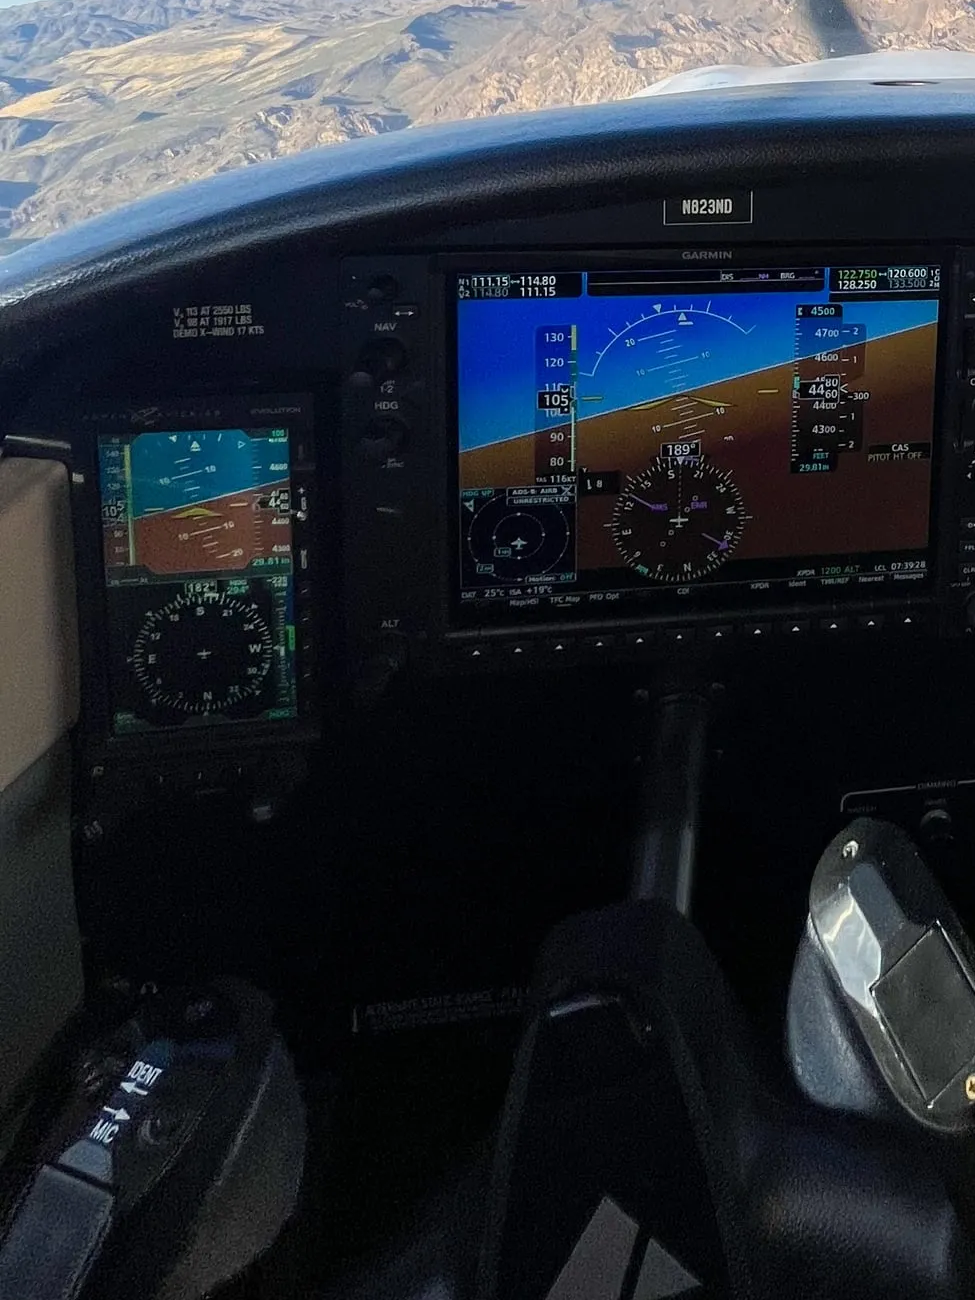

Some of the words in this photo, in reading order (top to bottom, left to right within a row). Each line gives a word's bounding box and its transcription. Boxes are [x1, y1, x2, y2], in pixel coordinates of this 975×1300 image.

[682, 198, 733, 215] N823ND
[682, 251, 733, 260] GARMIN
[838, 269, 877, 279] 122.750
[888, 268, 927, 278] 120.600
[473, 276, 509, 287] 111.15
[520, 276, 556, 286] 114.80
[838, 280, 877, 290] 128.250
[889, 279, 926, 288] 133.500
[473, 288, 509, 297] 114.80
[520, 287, 556, 297] 111.15
[200, 306, 211, 316] AT
[212, 305, 234, 315] 2550
[235, 304, 252, 315] LBS
[811, 307, 835, 316] 4500
[200, 317, 210, 326] AT
[213, 316, 233, 326] 1917
[235, 315, 252, 325] LBS
[237, 326, 247, 336] 17
[248, 325, 265, 335] KTS
[374, 323, 397, 331] NAV
[853, 327, 859, 336] 2
[544, 333, 565, 343] 130
[815, 329, 840, 338] 4700
[625, 338, 636, 347] 20
[701, 351, 711, 359] 10
[815, 353, 839, 362] 4600
[544, 358, 565, 367] 120
[636, 368, 646, 377] 10
[543, 395, 569, 406] 105
[374, 401, 399, 410] HDG
[716, 407, 725, 416] 10
[652, 425, 662, 434] 10
[812, 425, 836, 434] 4300
[550, 433, 565, 442] 90
[849, 441, 855, 449] 2
[892, 443, 909, 451] CAS
[868, 453, 892, 462] PITOT
[894, 453, 905, 461] HT
[907, 452, 922, 460] OFF
[550, 457, 564, 467] 80
[668, 470, 676, 479] S
[693, 470, 704, 479] 21
[683, 562, 692, 572] N
[821, 567, 841, 575] 1200
[844, 565, 860, 573] ALT
[891, 561, 926, 571] 07:39:28
[196, 606, 205, 616] S
[222, 609, 233, 617] 21
[381, 619, 400, 628] ALT
[249, 644, 262, 654] W
[148, 654, 157, 664] E
[203, 692, 213, 701] N
[127, 1060, 164, 1087] IDENT
[90, 1118, 120, 1144] MIC
